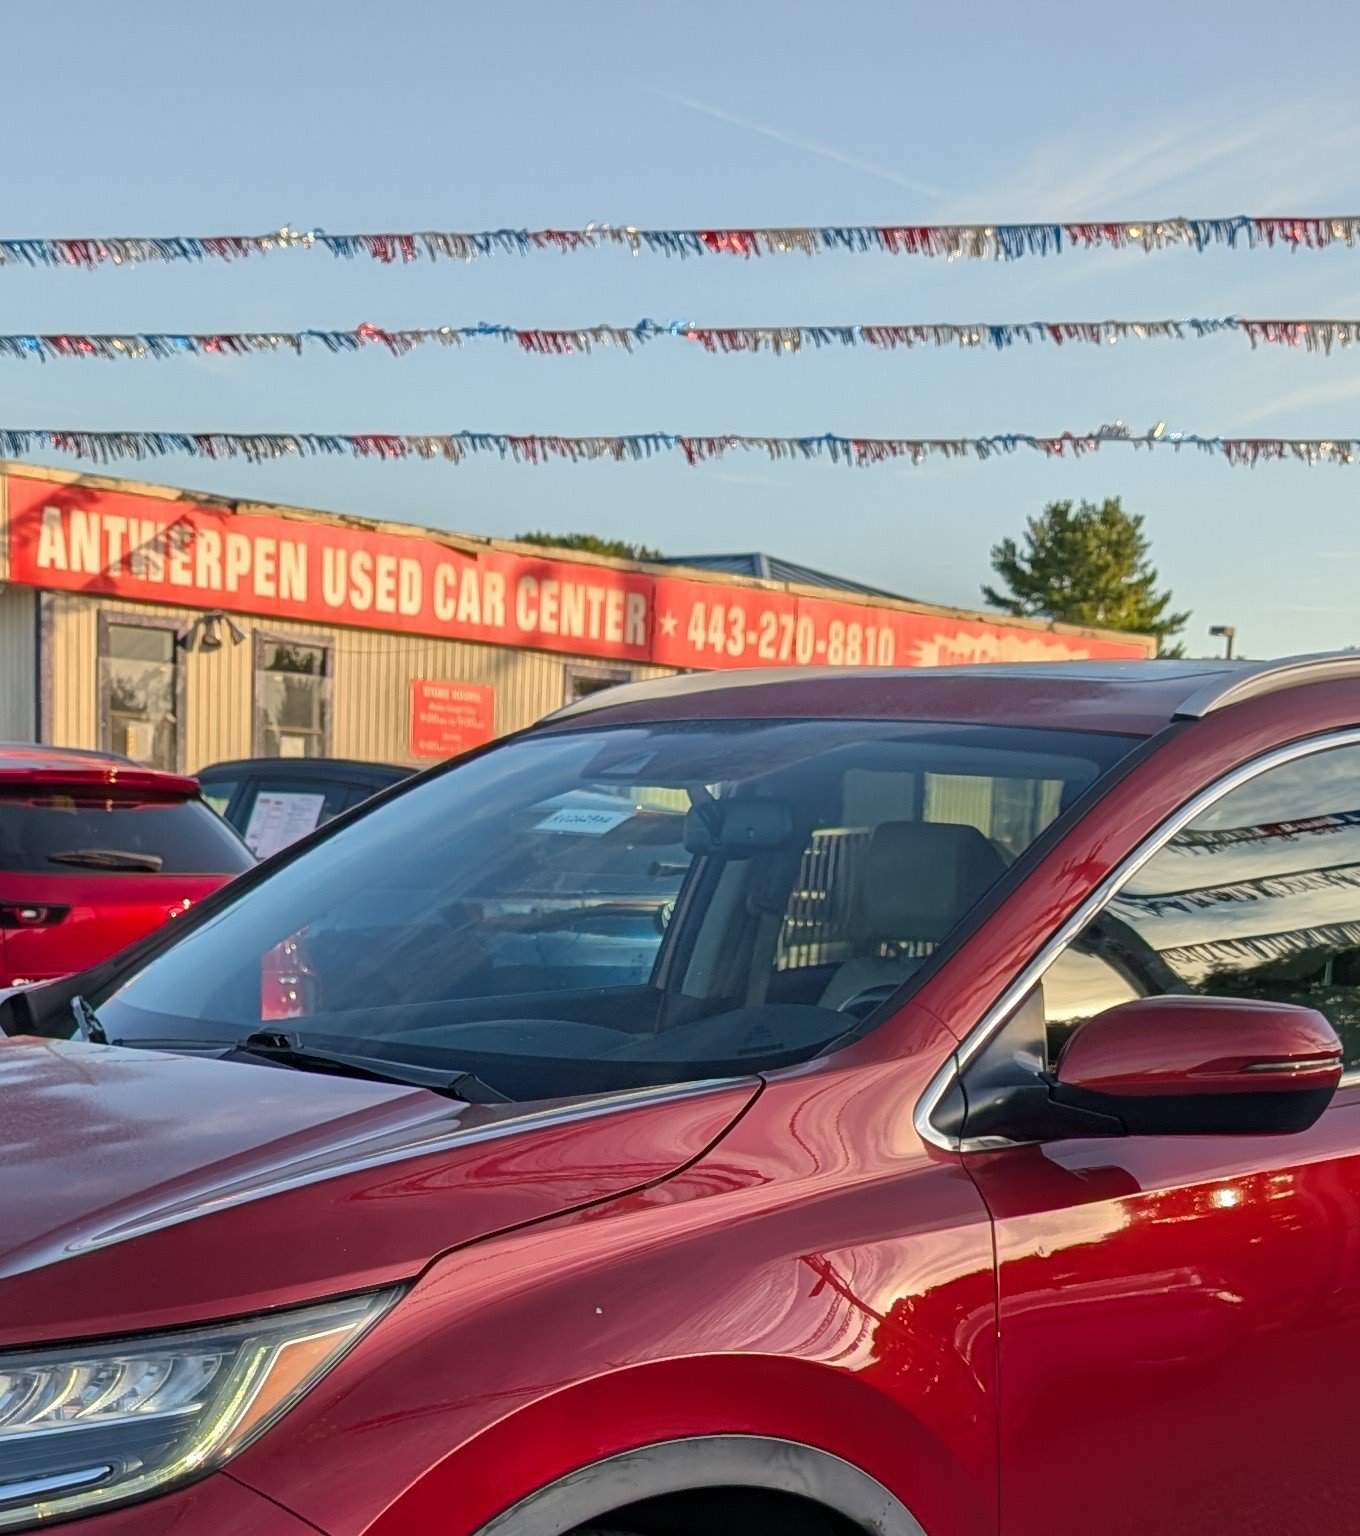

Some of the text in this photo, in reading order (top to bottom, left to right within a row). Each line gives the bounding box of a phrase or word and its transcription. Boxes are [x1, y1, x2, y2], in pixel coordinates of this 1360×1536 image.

[37, 505, 896, 667] ANTWERPEN USED CAR CENTER 443-270-8810
